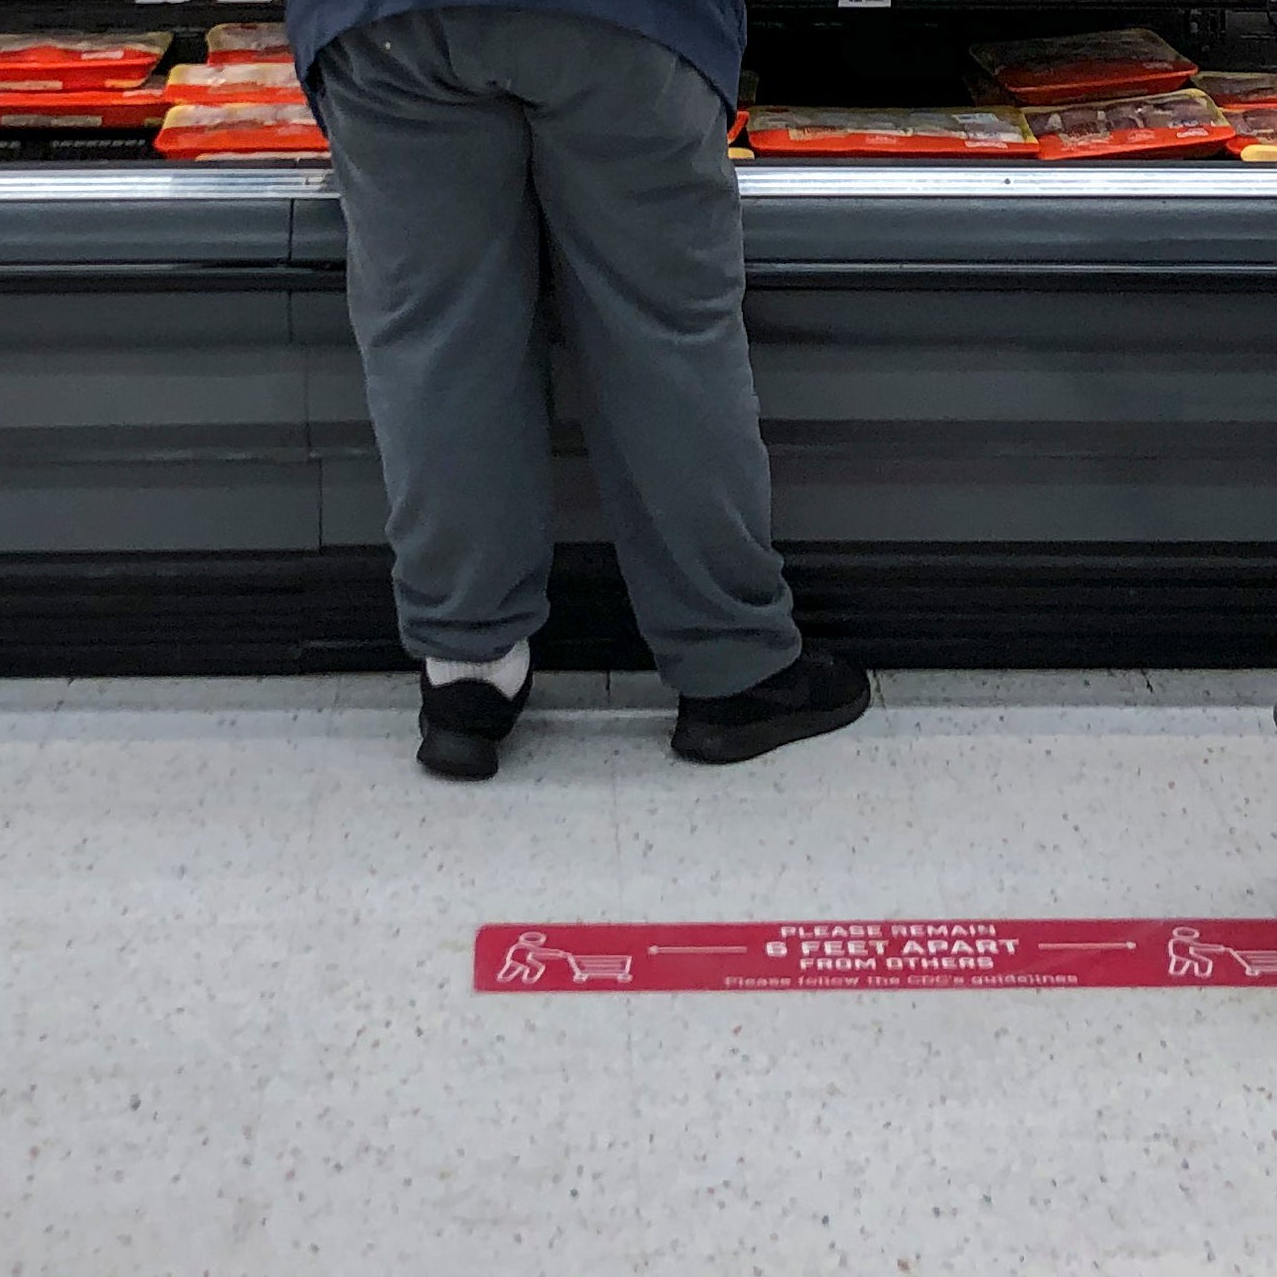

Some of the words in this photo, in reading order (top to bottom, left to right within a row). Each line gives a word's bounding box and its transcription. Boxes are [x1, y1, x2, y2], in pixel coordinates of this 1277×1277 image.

[780, 924, 883, 939] PLEASE
[891, 924, 997, 938] REMAIN
[766, 941, 788, 958] 6
[801, 940, 890, 957] FEET
[902, 938, 1020, 956] APART
[799, 957, 877, 971] FROM
[885, 957, 994, 971] OTHERS
[725, 976, 792, 987] Please
[797, 975, 860, 986] follow
[867, 975, 901, 986] the
[907, 974, 965, 986] CDC's
[971, 974, 1079, 987] guidelines
